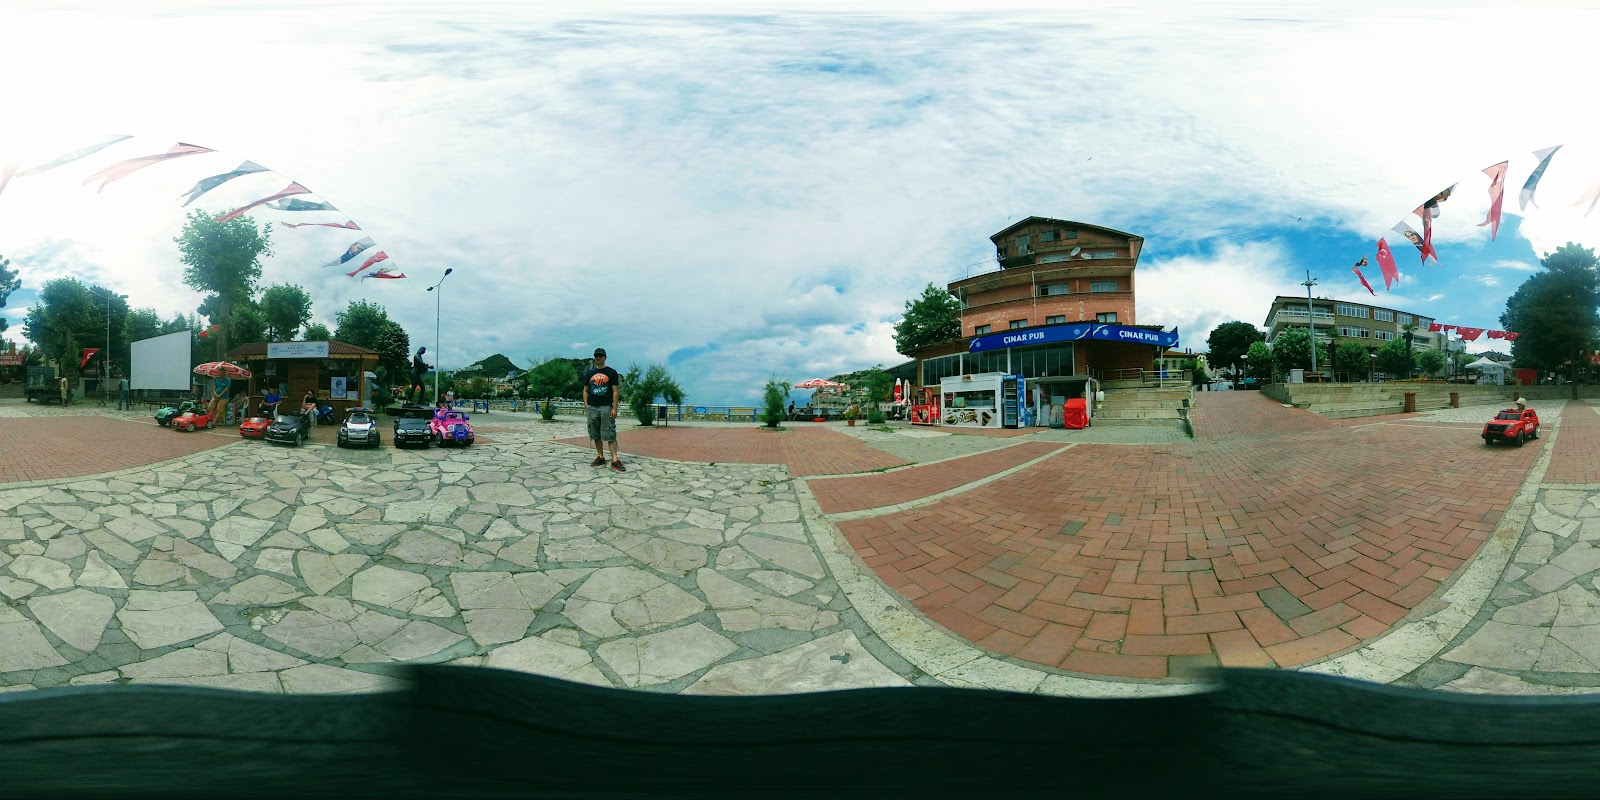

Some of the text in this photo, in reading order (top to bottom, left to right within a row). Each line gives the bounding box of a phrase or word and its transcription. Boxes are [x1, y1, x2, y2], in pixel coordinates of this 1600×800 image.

[1003, 331, 1045, 345] ÇINAR PUB
[1119, 330, 1159, 342] ÇINAR PUB
